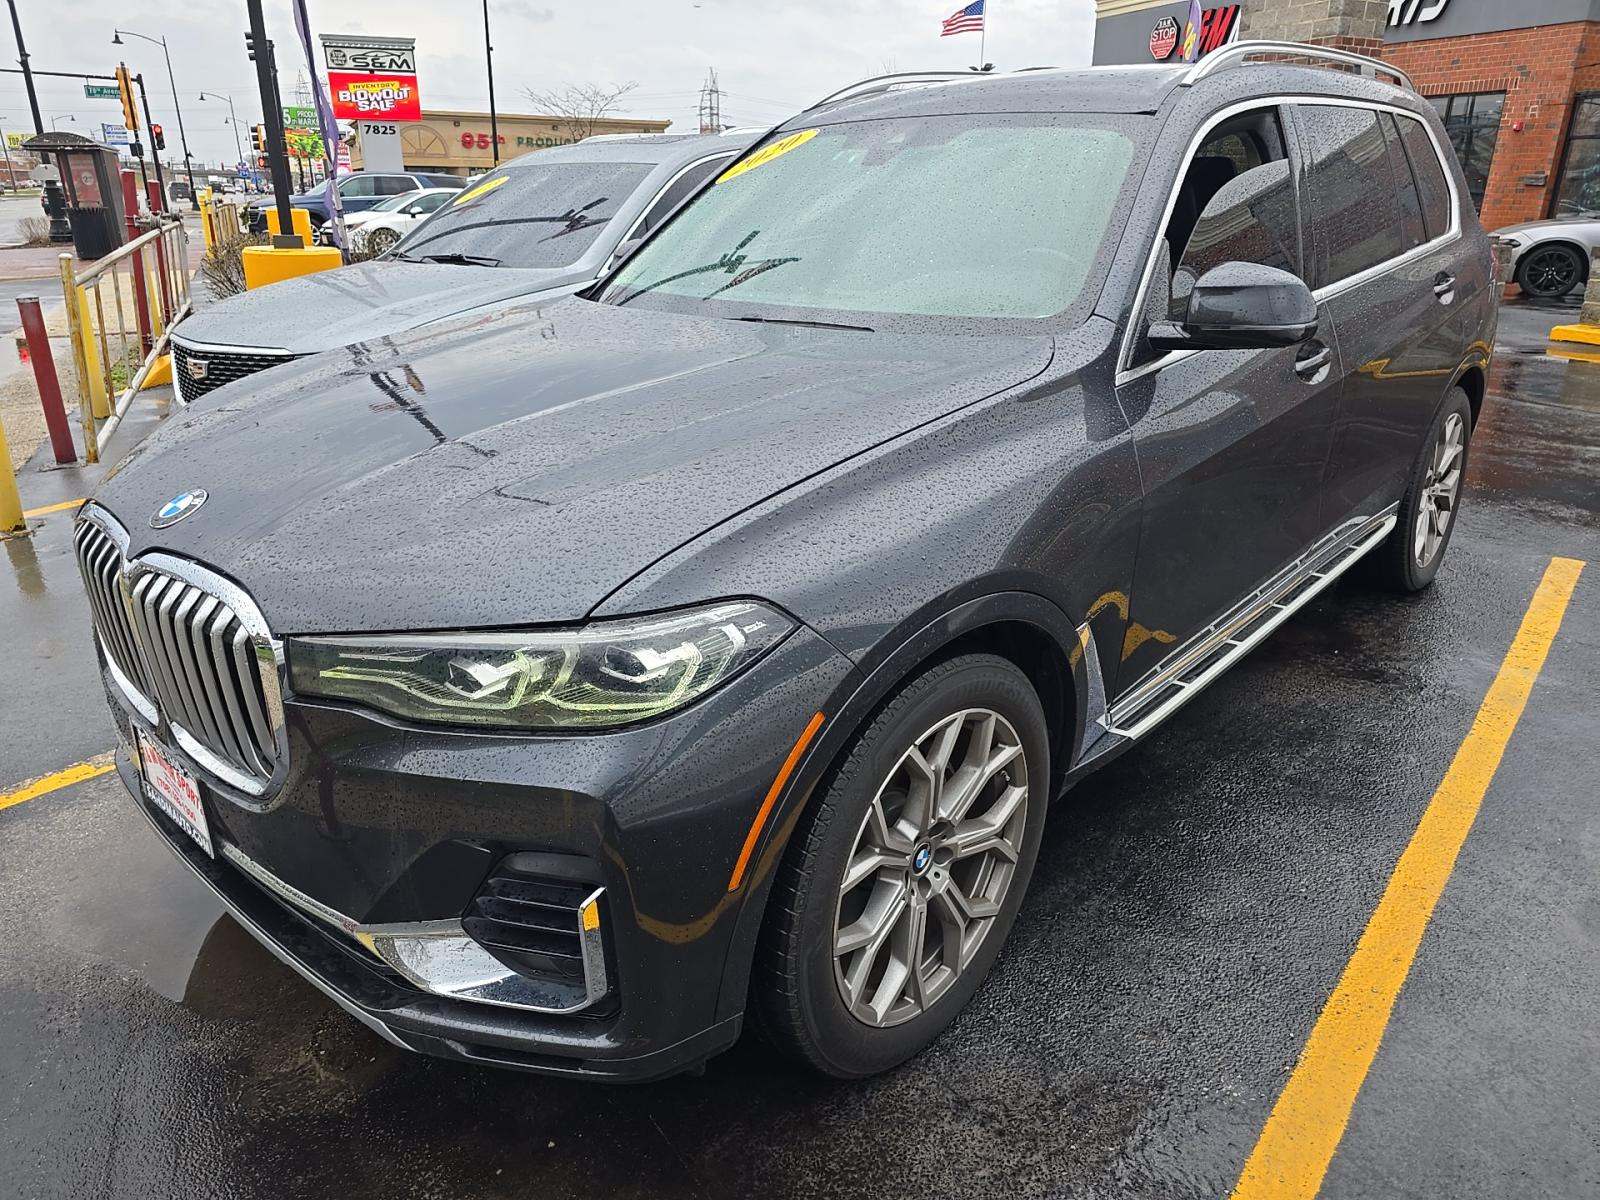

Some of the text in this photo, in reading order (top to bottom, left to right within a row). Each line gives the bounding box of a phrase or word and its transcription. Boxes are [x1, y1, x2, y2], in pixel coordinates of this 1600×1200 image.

[1152, 27, 1176, 42] STOP
[352, 82, 396, 90] INVENTORY
[338, 87, 411, 103] BLOWOUT
[356, 100, 396, 112] SALE
[364, 124, 397, 135] 7825
[461, 132, 506, 150] 95h
